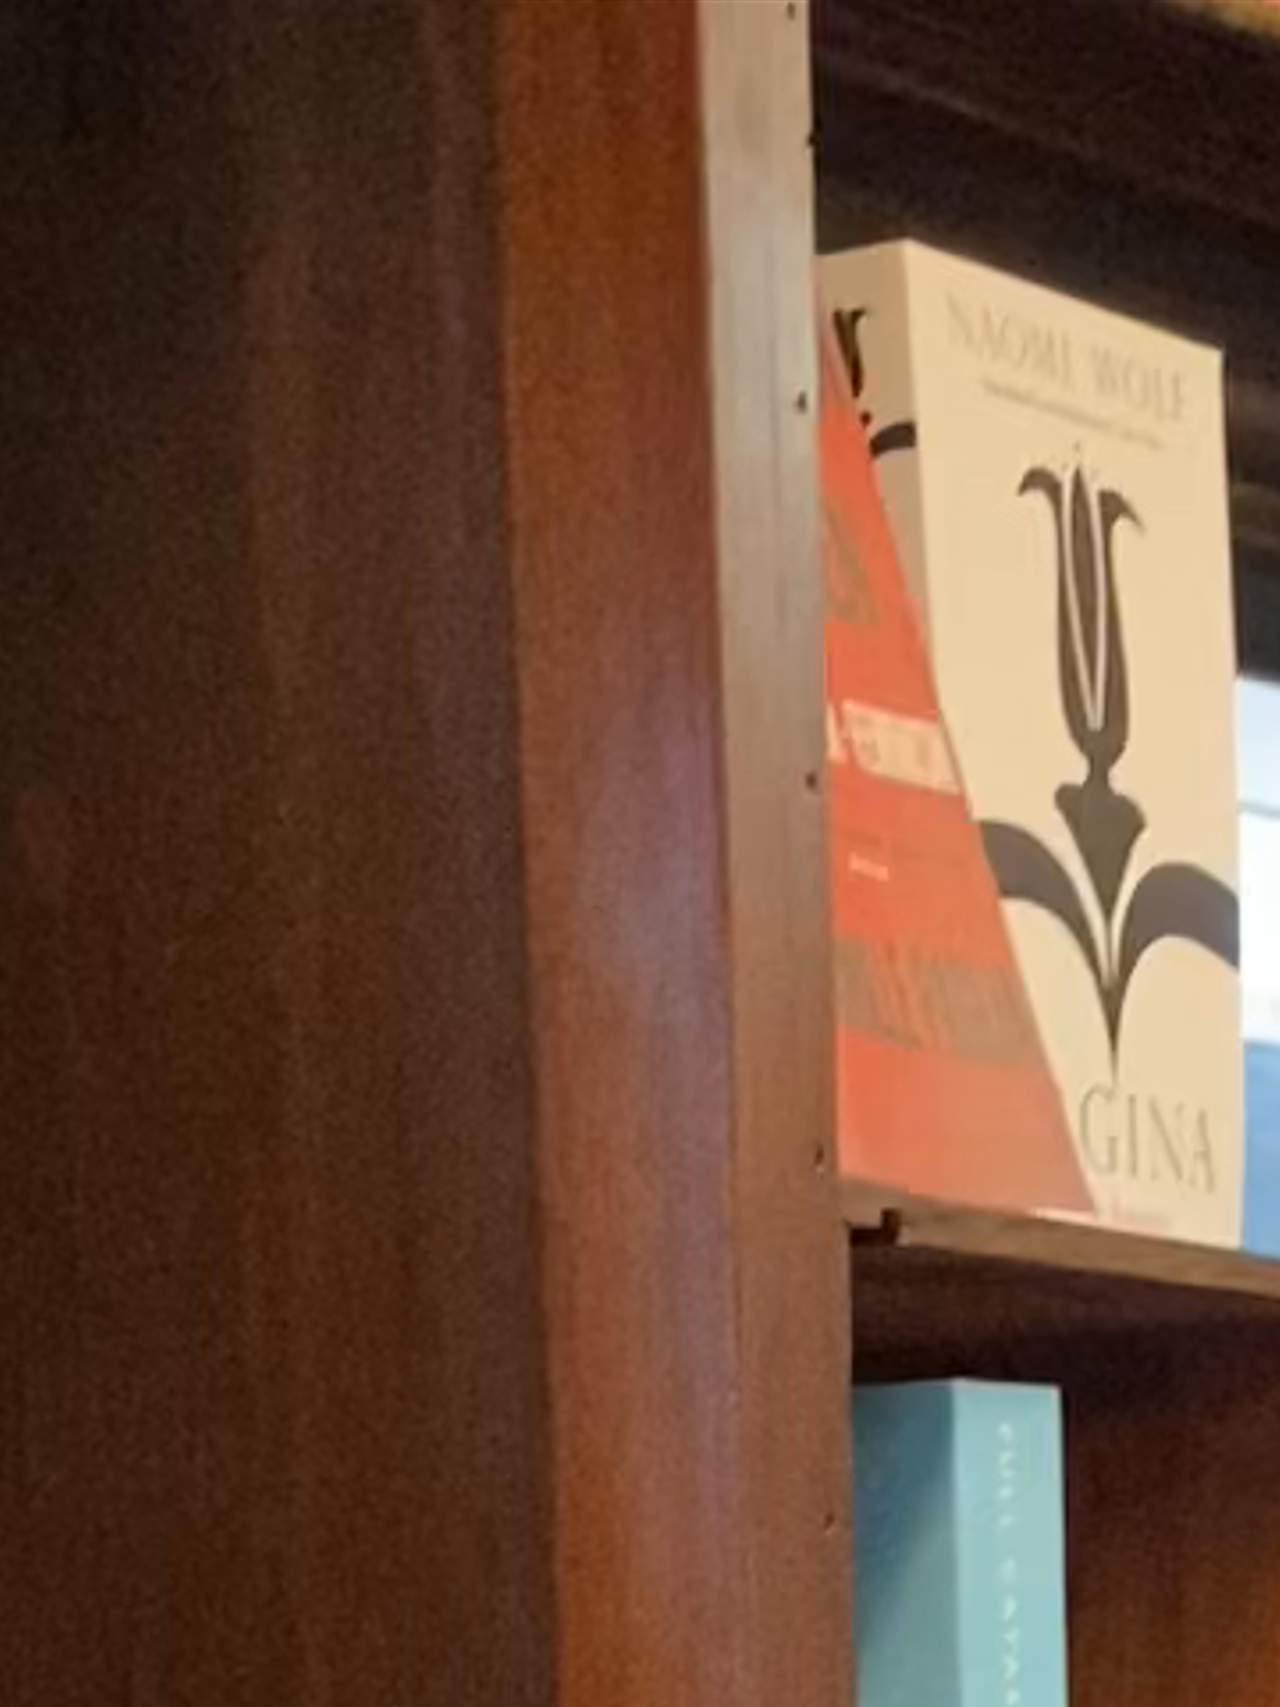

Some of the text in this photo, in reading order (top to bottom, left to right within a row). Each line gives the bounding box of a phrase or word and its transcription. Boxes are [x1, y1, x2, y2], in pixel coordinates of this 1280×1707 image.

[945, 292, 1186, 424] NAOMI WOLF
[1077, 1082, 1218, 1196] GINA
